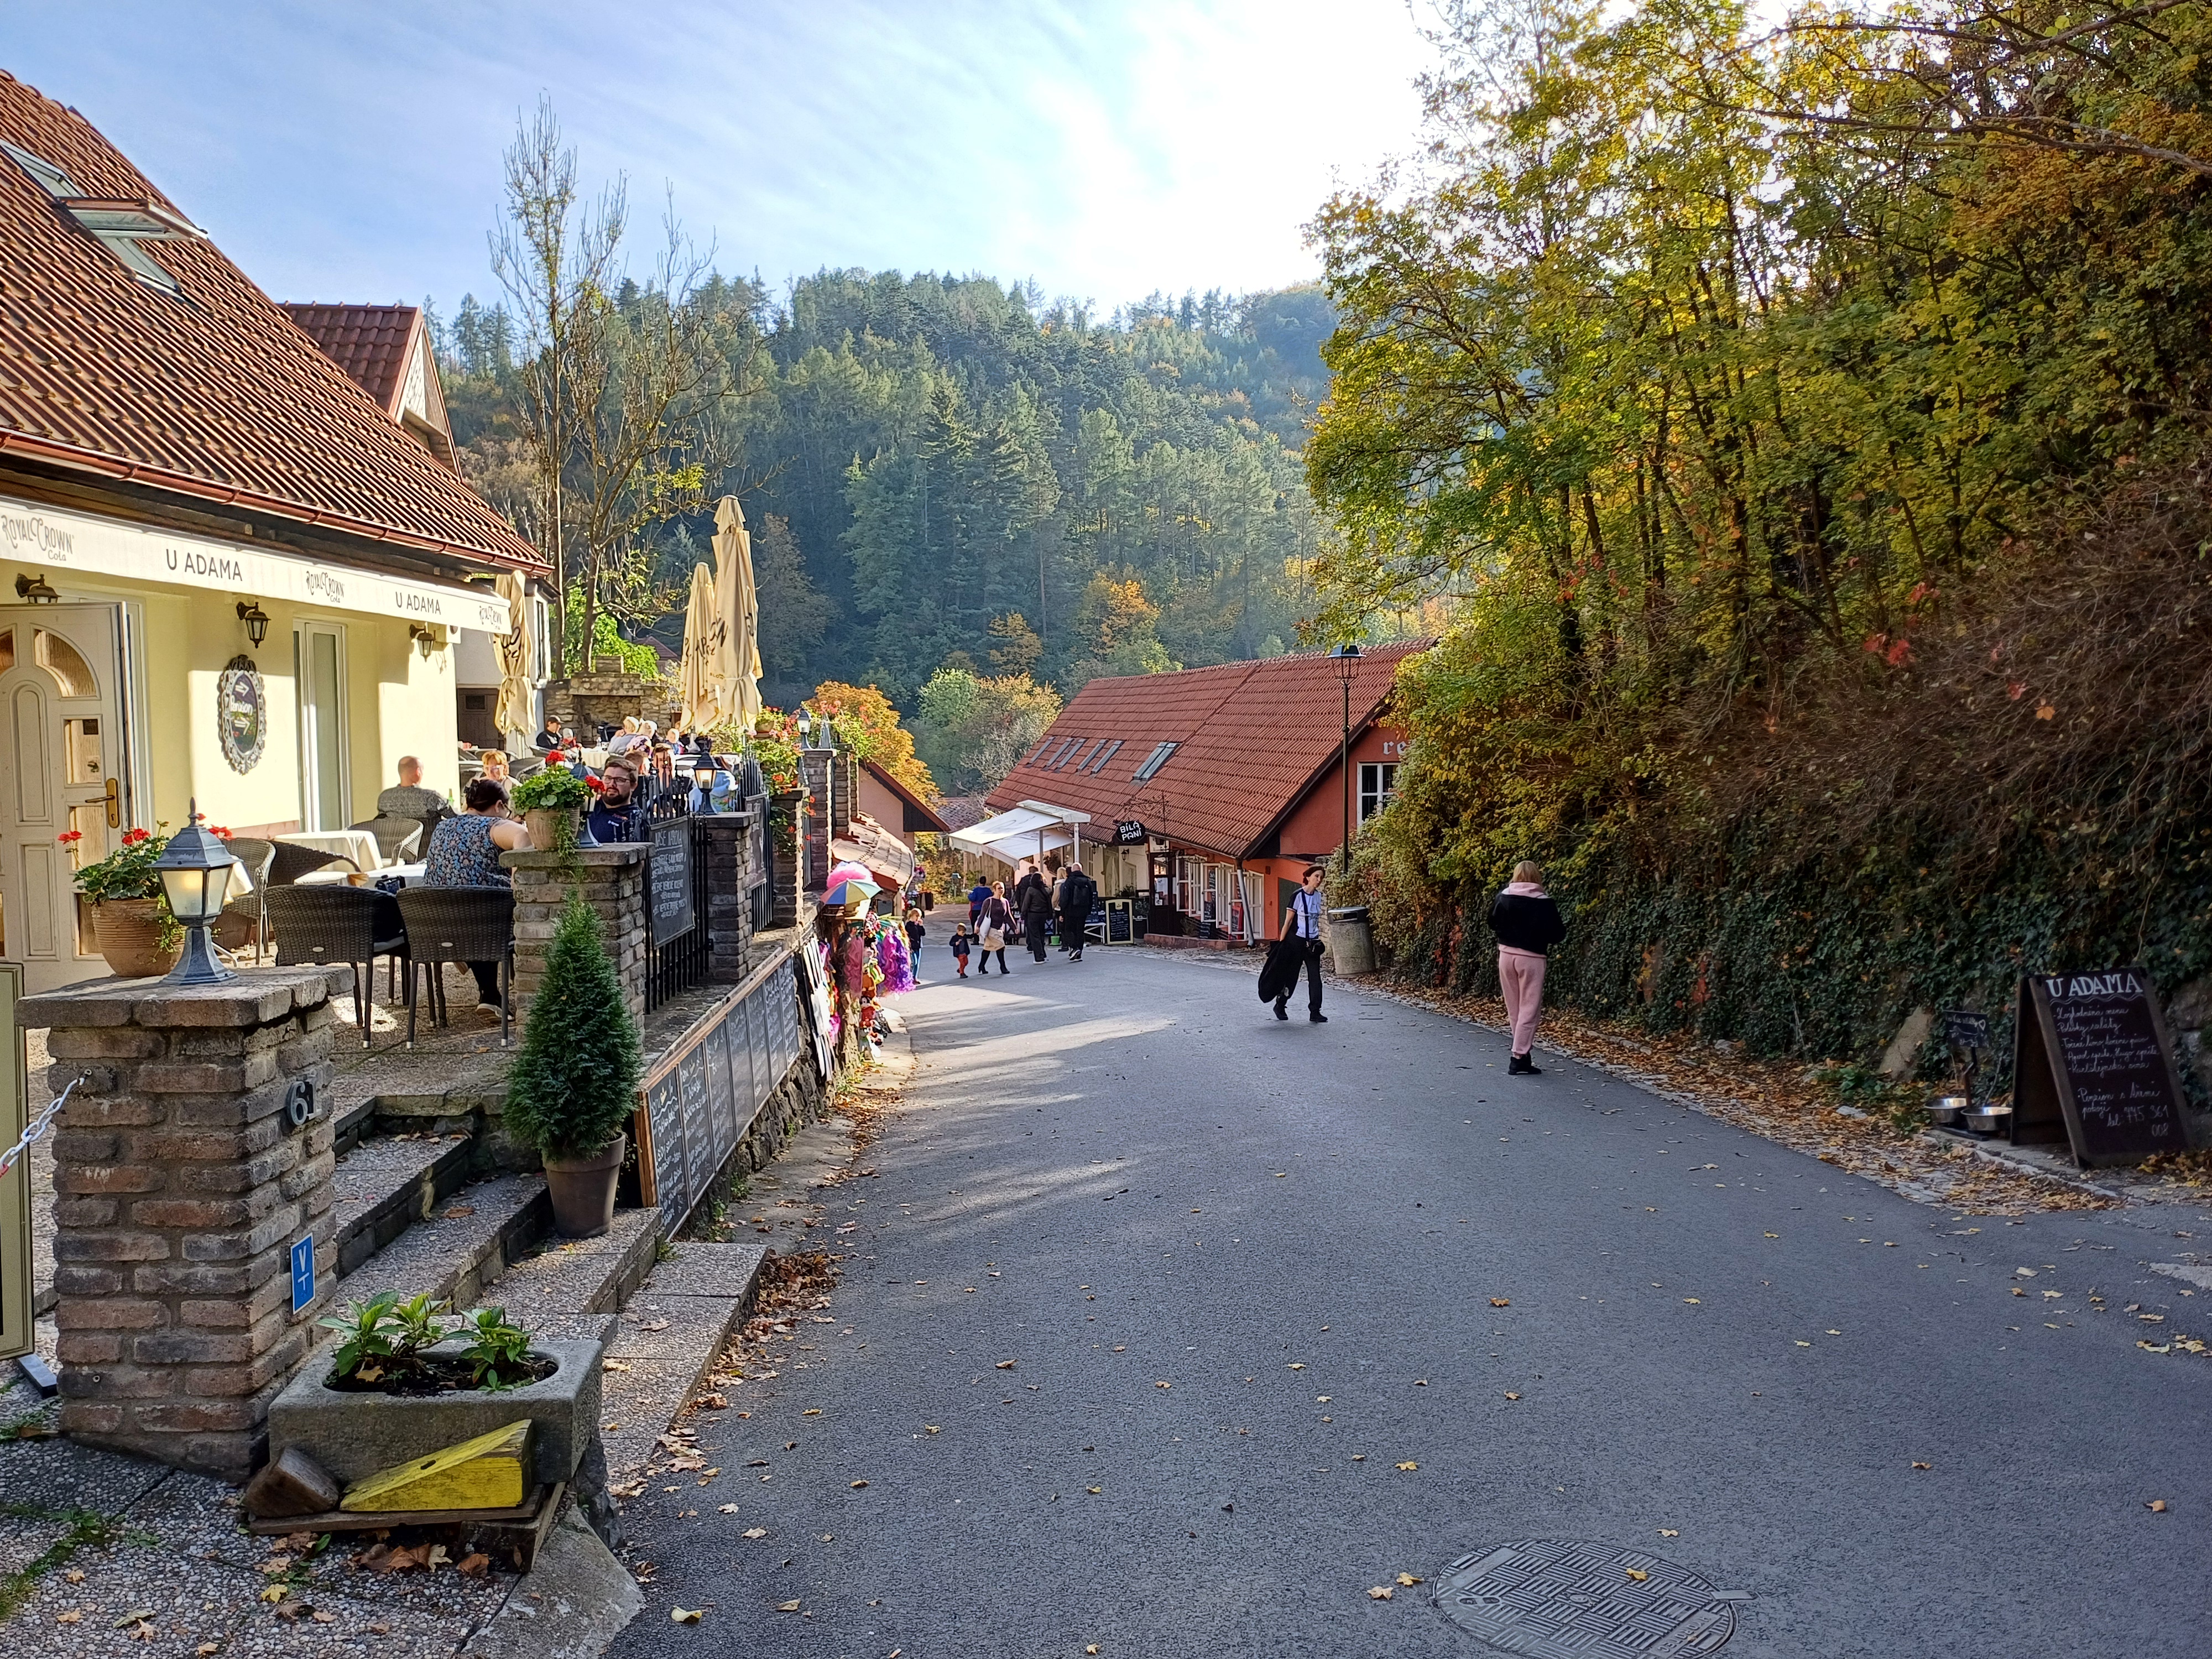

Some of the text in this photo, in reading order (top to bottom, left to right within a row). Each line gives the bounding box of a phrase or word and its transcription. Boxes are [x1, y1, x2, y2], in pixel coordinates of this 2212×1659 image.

[30, 517, 72, 554] CROWN
[48, 550, 66, 561] Cola
[166, 549, 243, 581] U ADAMA
[395, 591, 441, 615] U ADAMA
[1383, 741, 1410, 755] re
[1121, 828, 1141, 841] PANÍ
[2046, 973, 2143, 997] U ADAMA
[2150, 1105, 2169, 1119] 361
